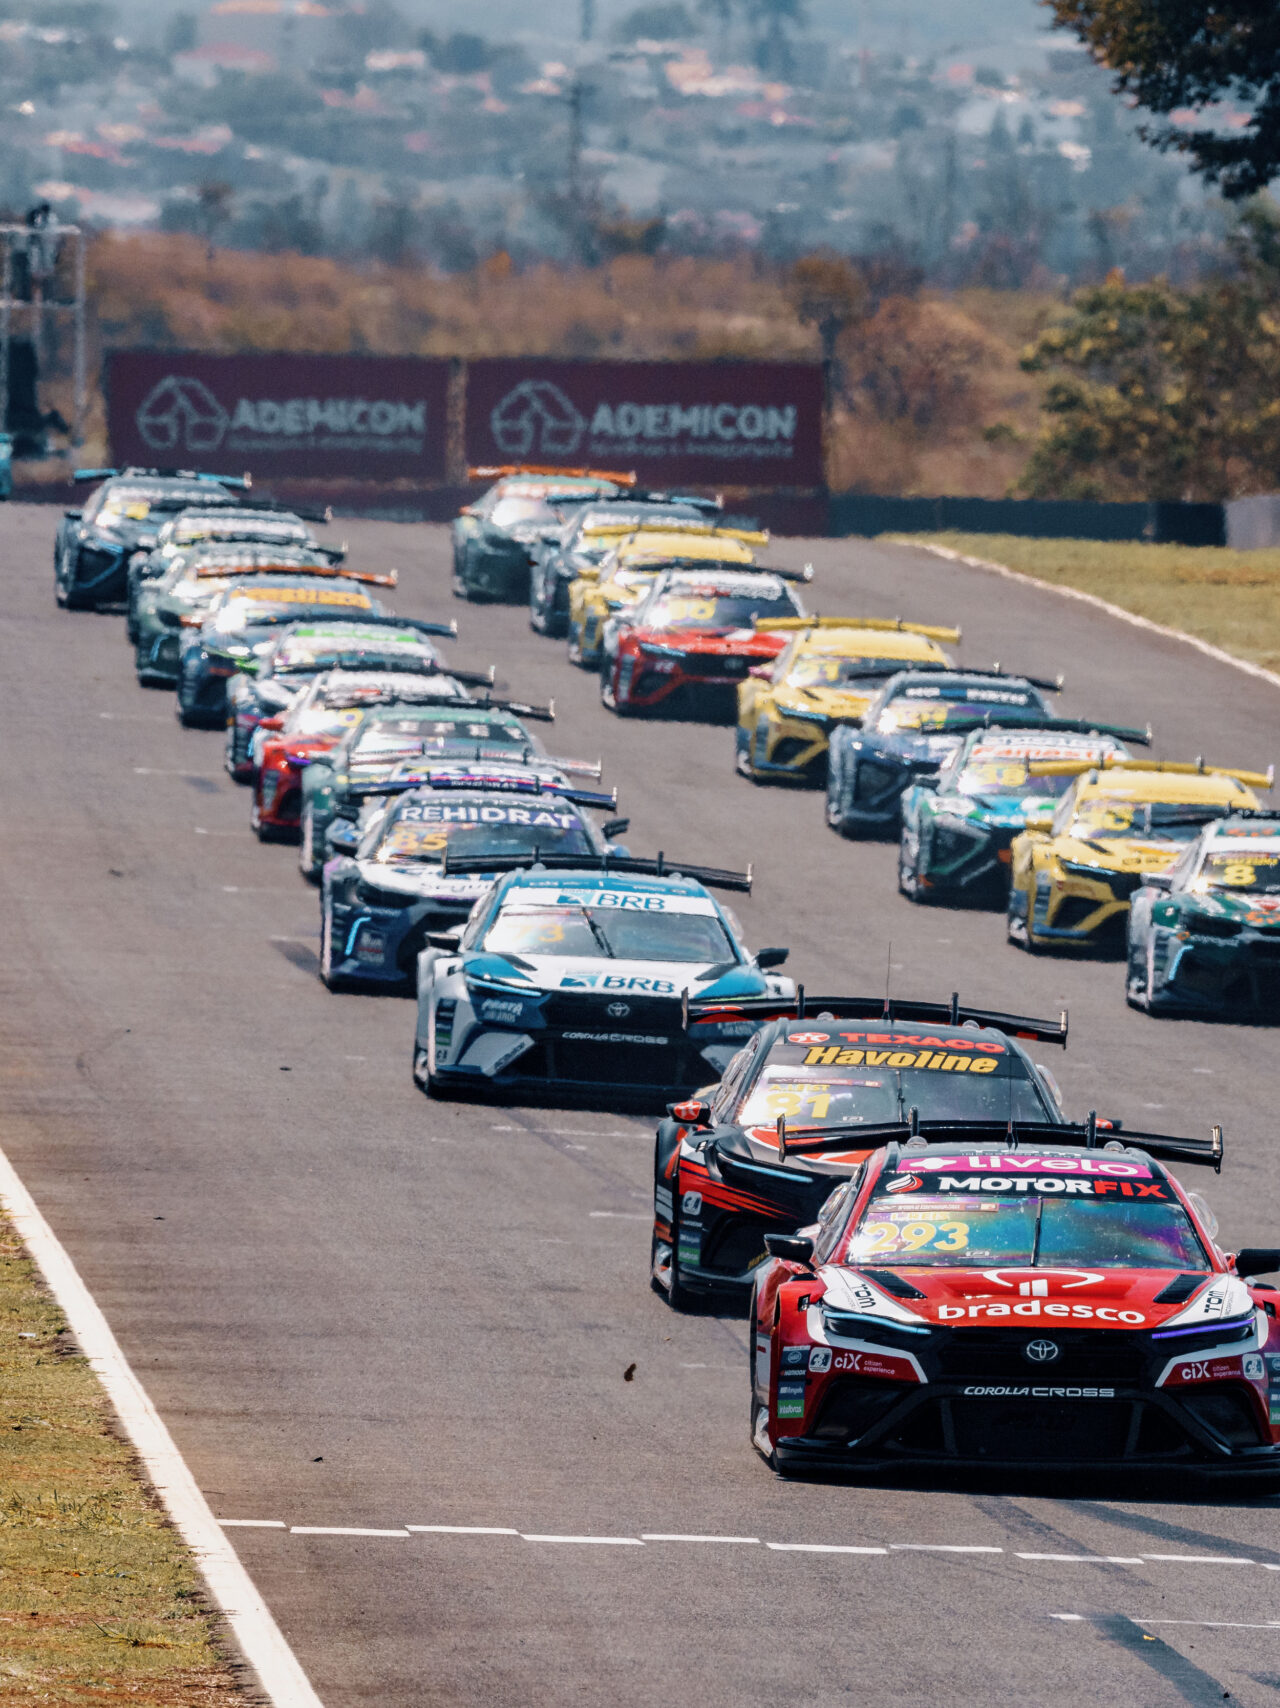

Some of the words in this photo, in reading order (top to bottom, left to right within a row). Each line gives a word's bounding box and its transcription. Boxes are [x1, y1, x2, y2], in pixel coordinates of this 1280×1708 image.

[231, 397, 425, 435] ADEMICON
[590, 402, 798, 440] ADEMICON
[401, 806, 576, 829] REHIDRAT
[1223, 864, 1257, 886] 8
[597, 893, 665, 911] BRB
[603, 975, 675, 994] BRB
[839, 1031, 1006, 1054] TEXACO
[803, 1046, 1000, 1074] Havoline
[765, 1092, 832, 1119] 81
[968, 1155, 1139, 1176] livelo
[937, 1176, 1168, 1199] MOTORFIX
[865, 1221, 970, 1252] 293
[938, 1300, 1146, 1324] bradesco
[863, 1365, 896, 1375] experience
[964, 1386, 1029, 1396] COROLLA
[1032, 1387, 1115, 1398] CROSS
